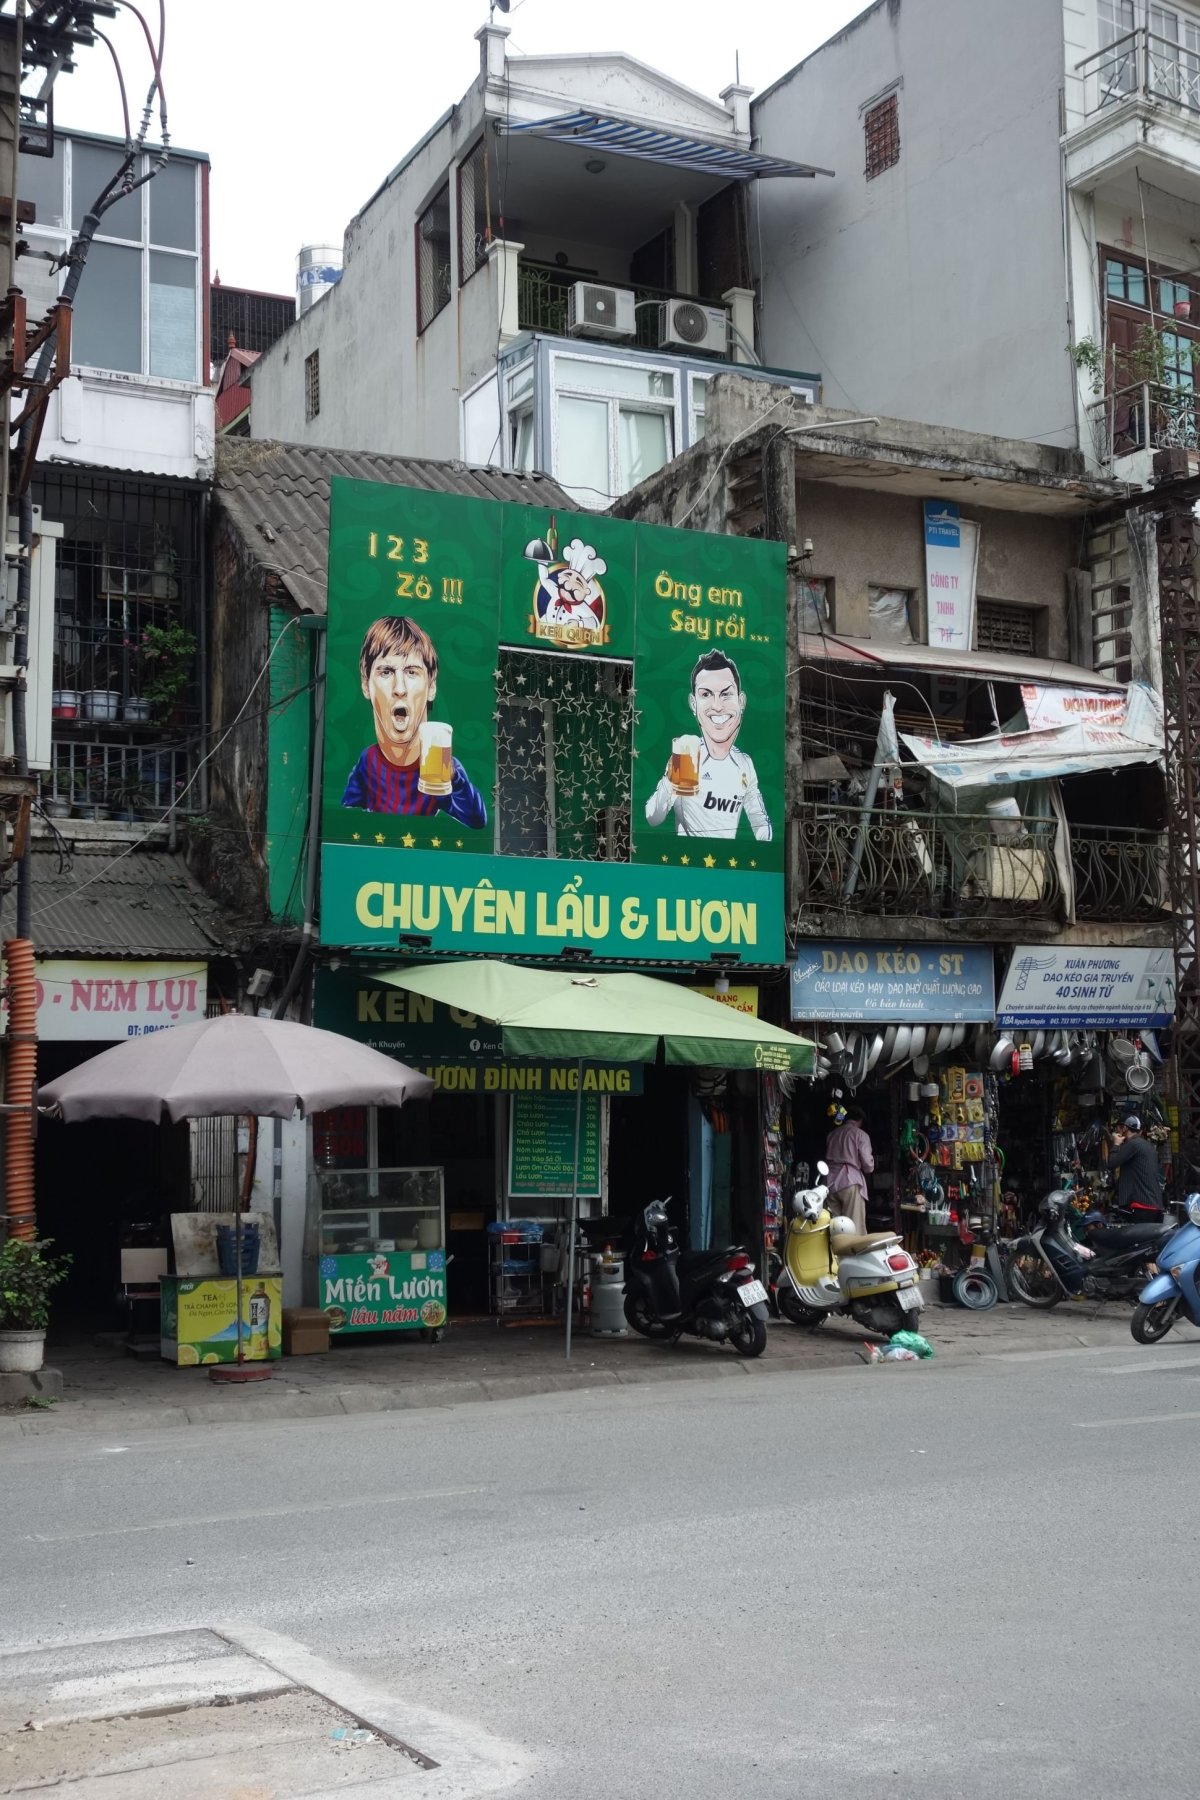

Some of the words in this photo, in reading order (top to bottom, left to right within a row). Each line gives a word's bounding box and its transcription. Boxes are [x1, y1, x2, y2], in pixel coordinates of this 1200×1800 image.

[938, 527, 959, 536] TRAVEL
[387, 534, 404, 561] 2
[412, 537, 430, 563] 3
[396, 571, 432, 599] Zô
[655, 570, 702, 607] Ông
[708, 586, 743, 607] em
[930, 571, 949, 589] CÔNG
[951, 576, 959, 590] TY
[936, 601, 954, 615] TNHH
[540, 624, 563, 639] KEN
[669, 609, 710, 641] Say
[355, 878, 526, 935] CHUYÊN
[536, 875, 610, 939] LẨU
[620, 897, 649, 940] &
[656, 898, 757, 945] LƯƠN
[822, 950, 869, 974] DAO
[876, 946, 921, 976] KÉO
[939, 953, 965, 976] ST
[1065, 957, 1086, 969] XUÂN
[1087, 959, 1120, 970] PHƯƠNG
[814, 977, 831, 993] CÁC
[832, 981, 848, 996] LOẠI
[850, 979, 865, 993] KÉO
[868, 983, 884, 994] MAY
[888, 983, 903, 994] DAO
[905, 979, 921, 995] PHỞ
[967, 984, 983, 995] CAO
[1043, 973, 1063, 982] DAO
[1064, 971, 1082, 982] KÉO
[1084, 974, 1098, 982] GIA
[70, 979, 138, 1012] NEM
[147, 979, 197, 1019] LỤI
[1056, 985, 1070, 998] 40
[1071, 986, 1097, 998] SINH
[1100, 984, 1114, 998] TỪ
[358, 990, 434, 1024] KEN
[899, 999, 924, 1009] hành
[127, 1025, 141, 1036] ĐT:
[378, 1040, 406, 1050] Khuyến
[484, 1063, 541, 1090] ĐÌNH
[550, 1068, 630, 1091] NGANG
[325, 1274, 381, 1303] Miến
[388, 1275, 444, 1300] Lươn
[350, 1306, 379, 1326] lâu
[381, 1304, 419, 1324] năm
